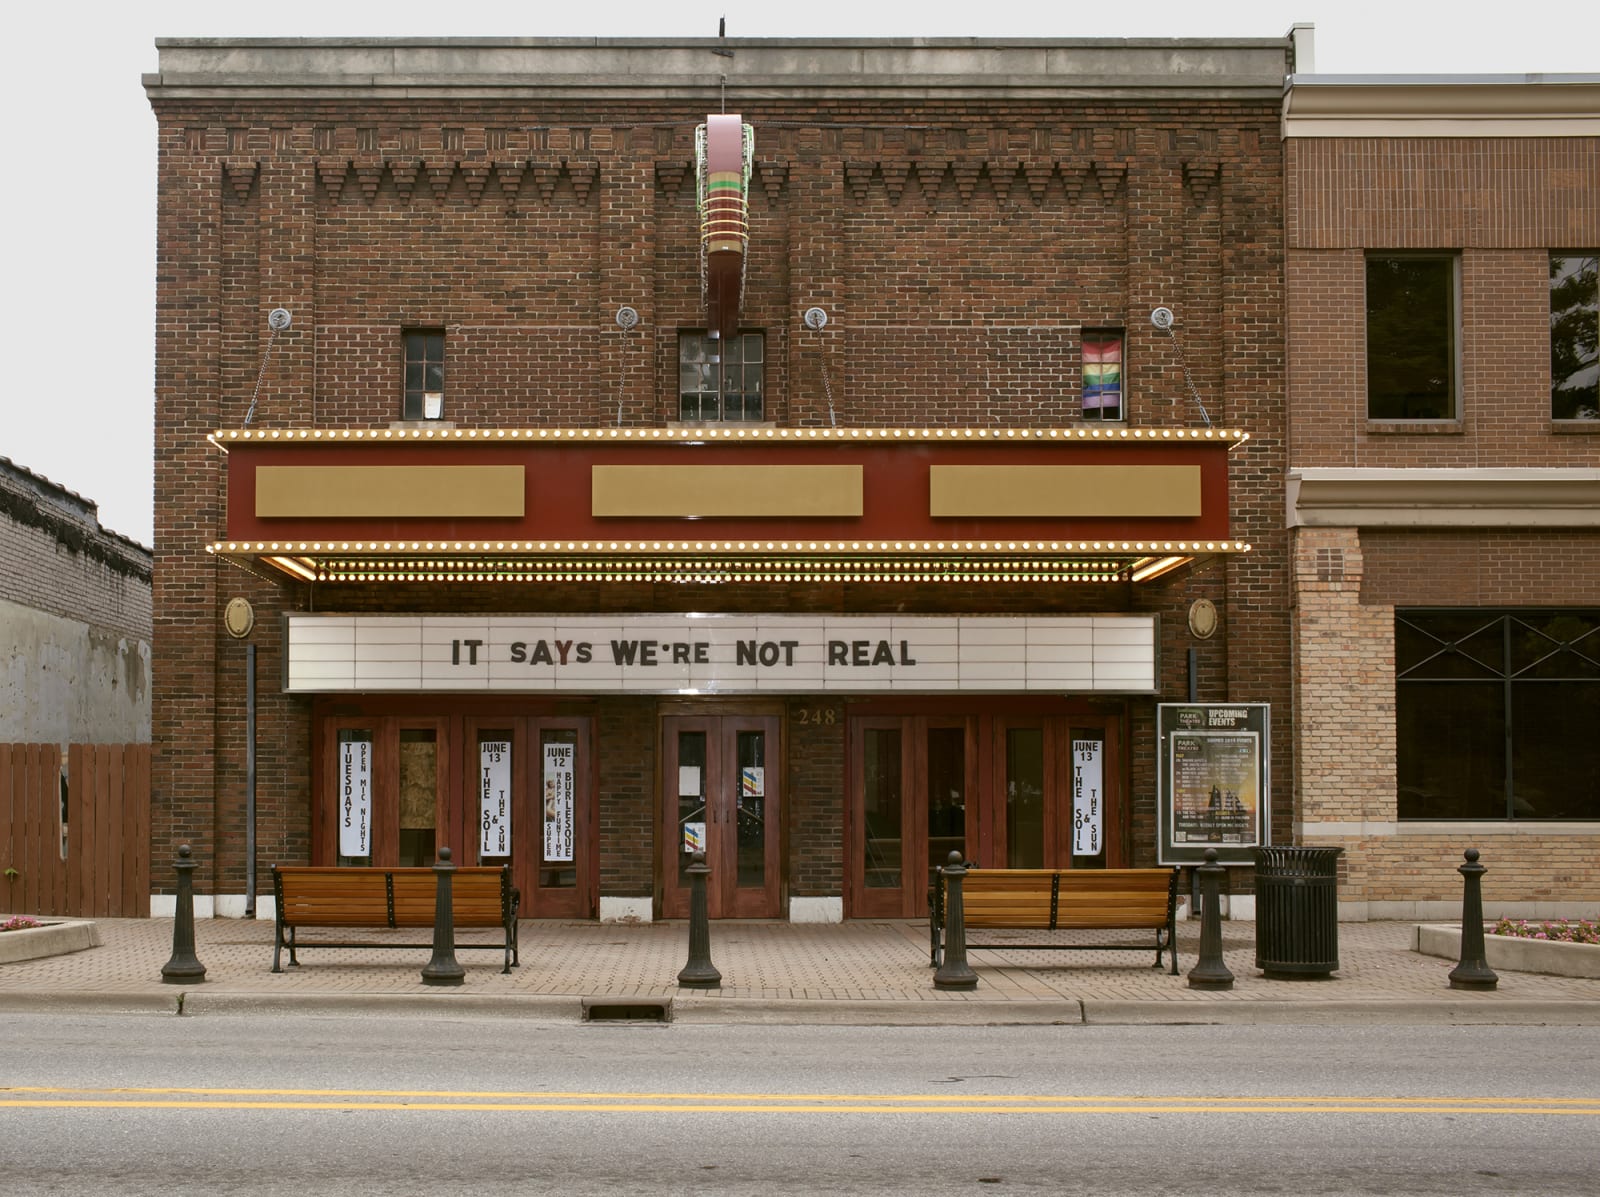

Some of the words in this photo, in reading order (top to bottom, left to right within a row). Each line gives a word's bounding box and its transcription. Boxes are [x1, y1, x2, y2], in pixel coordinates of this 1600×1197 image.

[451, 640, 483, 666] IT
[510, 640, 593, 666] SAYS
[736, 640, 800, 667] NOT
[827, 640, 917, 667] REAL
[798, 708, 836, 725] 248
[1208, 709, 1248, 718] UPCOMING
[1208, 718, 1236, 726] EVENTS
[482, 743, 506, 753] JUNE
[546, 747, 571, 757] JUNE
[1074, 742, 1098, 752] JUNE
[489, 753, 500, 762] 13
[1081, 752, 1093, 761] 13
[553, 758, 565, 767] 12
[492, 814, 498, 824] &
[1084, 814, 1090, 823] &
[1075, 808, 1083, 851] SOIL
